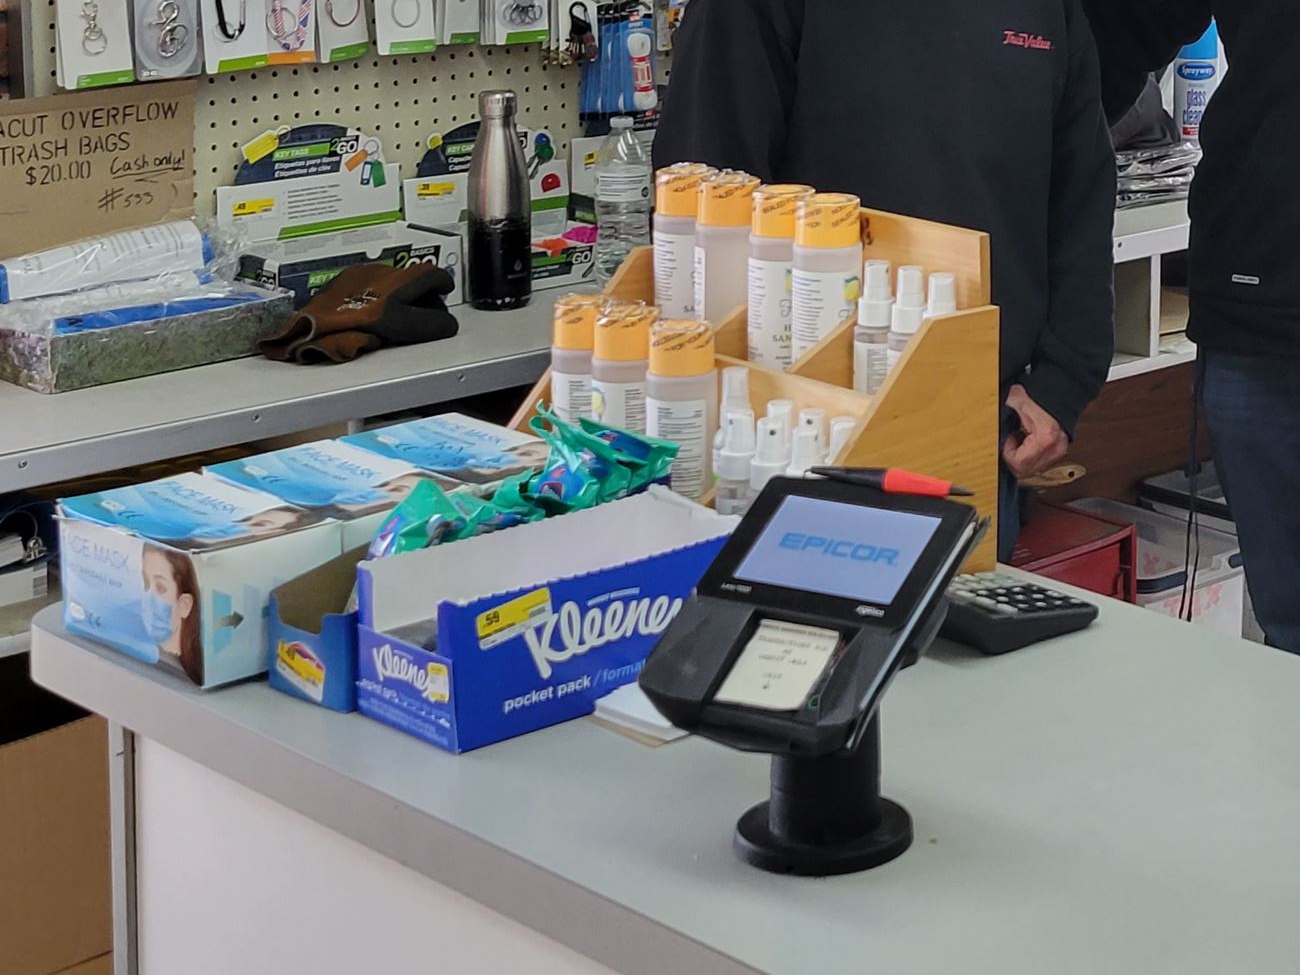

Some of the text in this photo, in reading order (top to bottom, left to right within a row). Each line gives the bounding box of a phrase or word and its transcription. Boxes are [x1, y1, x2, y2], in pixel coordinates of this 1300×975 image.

[1187, 89, 1207, 107] glass
[62, 102, 179, 130] OVERFLOW
[1, 132, 130, 165] TRASH BAGS
[273, 147, 310, 159] KEY TAGS
[25, 149, 185, 185] $20.00 Cash only!
[779, 532, 899, 566] EPICOR
[373, 645, 430, 695] Kleene
[504, 687, 553, 714] pocket
[558, 675, 591, 699] pack
